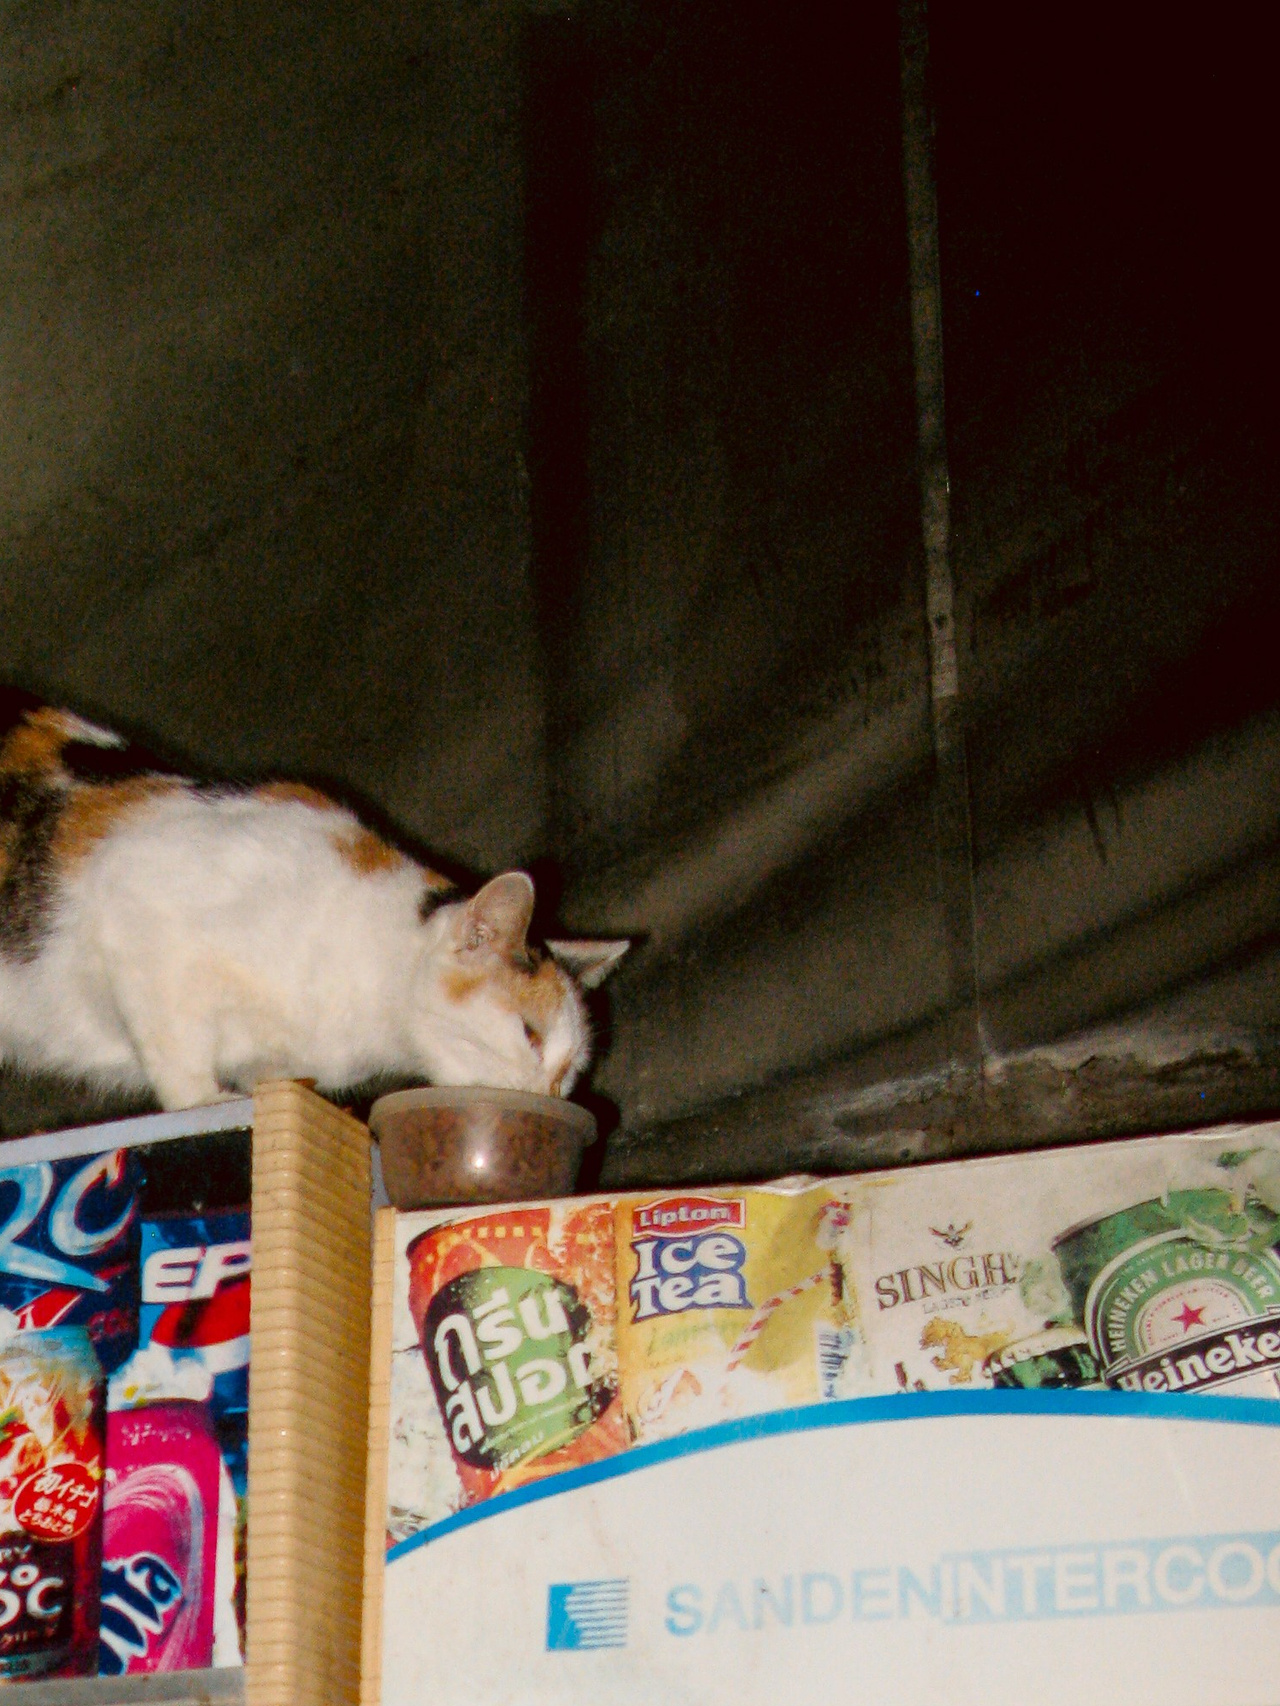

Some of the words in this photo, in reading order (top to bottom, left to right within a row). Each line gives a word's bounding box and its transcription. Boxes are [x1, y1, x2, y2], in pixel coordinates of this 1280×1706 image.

[639, 1203, 730, 1228] Lipton
[874, 1251, 1019, 1312] SINGH
[1161, 1252, 1230, 1278] LAGER
[432, 1286, 570, 1391] กรีน
